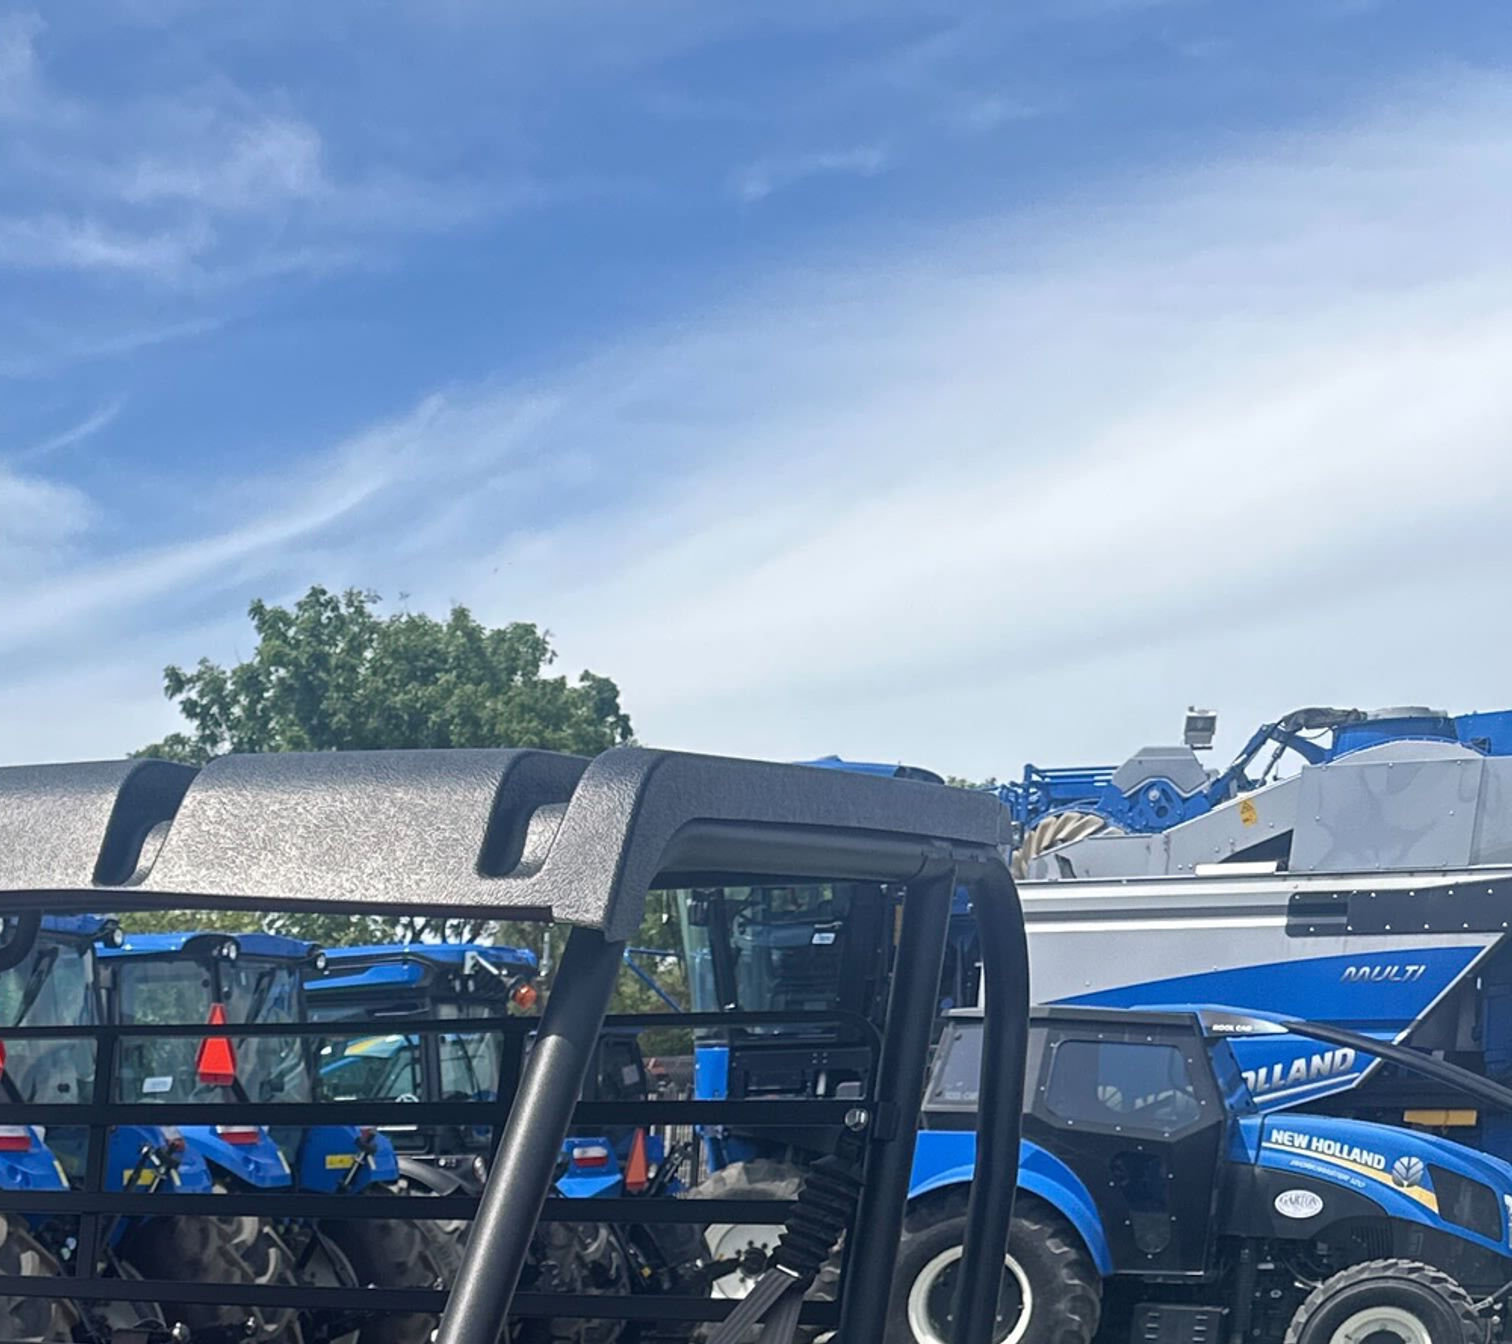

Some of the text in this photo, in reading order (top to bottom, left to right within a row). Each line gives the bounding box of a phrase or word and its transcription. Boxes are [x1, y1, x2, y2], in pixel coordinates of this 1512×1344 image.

[1340, 965, 1426, 982] MULTI
[1271, 1128, 1386, 1170] NEW HOLLAND
